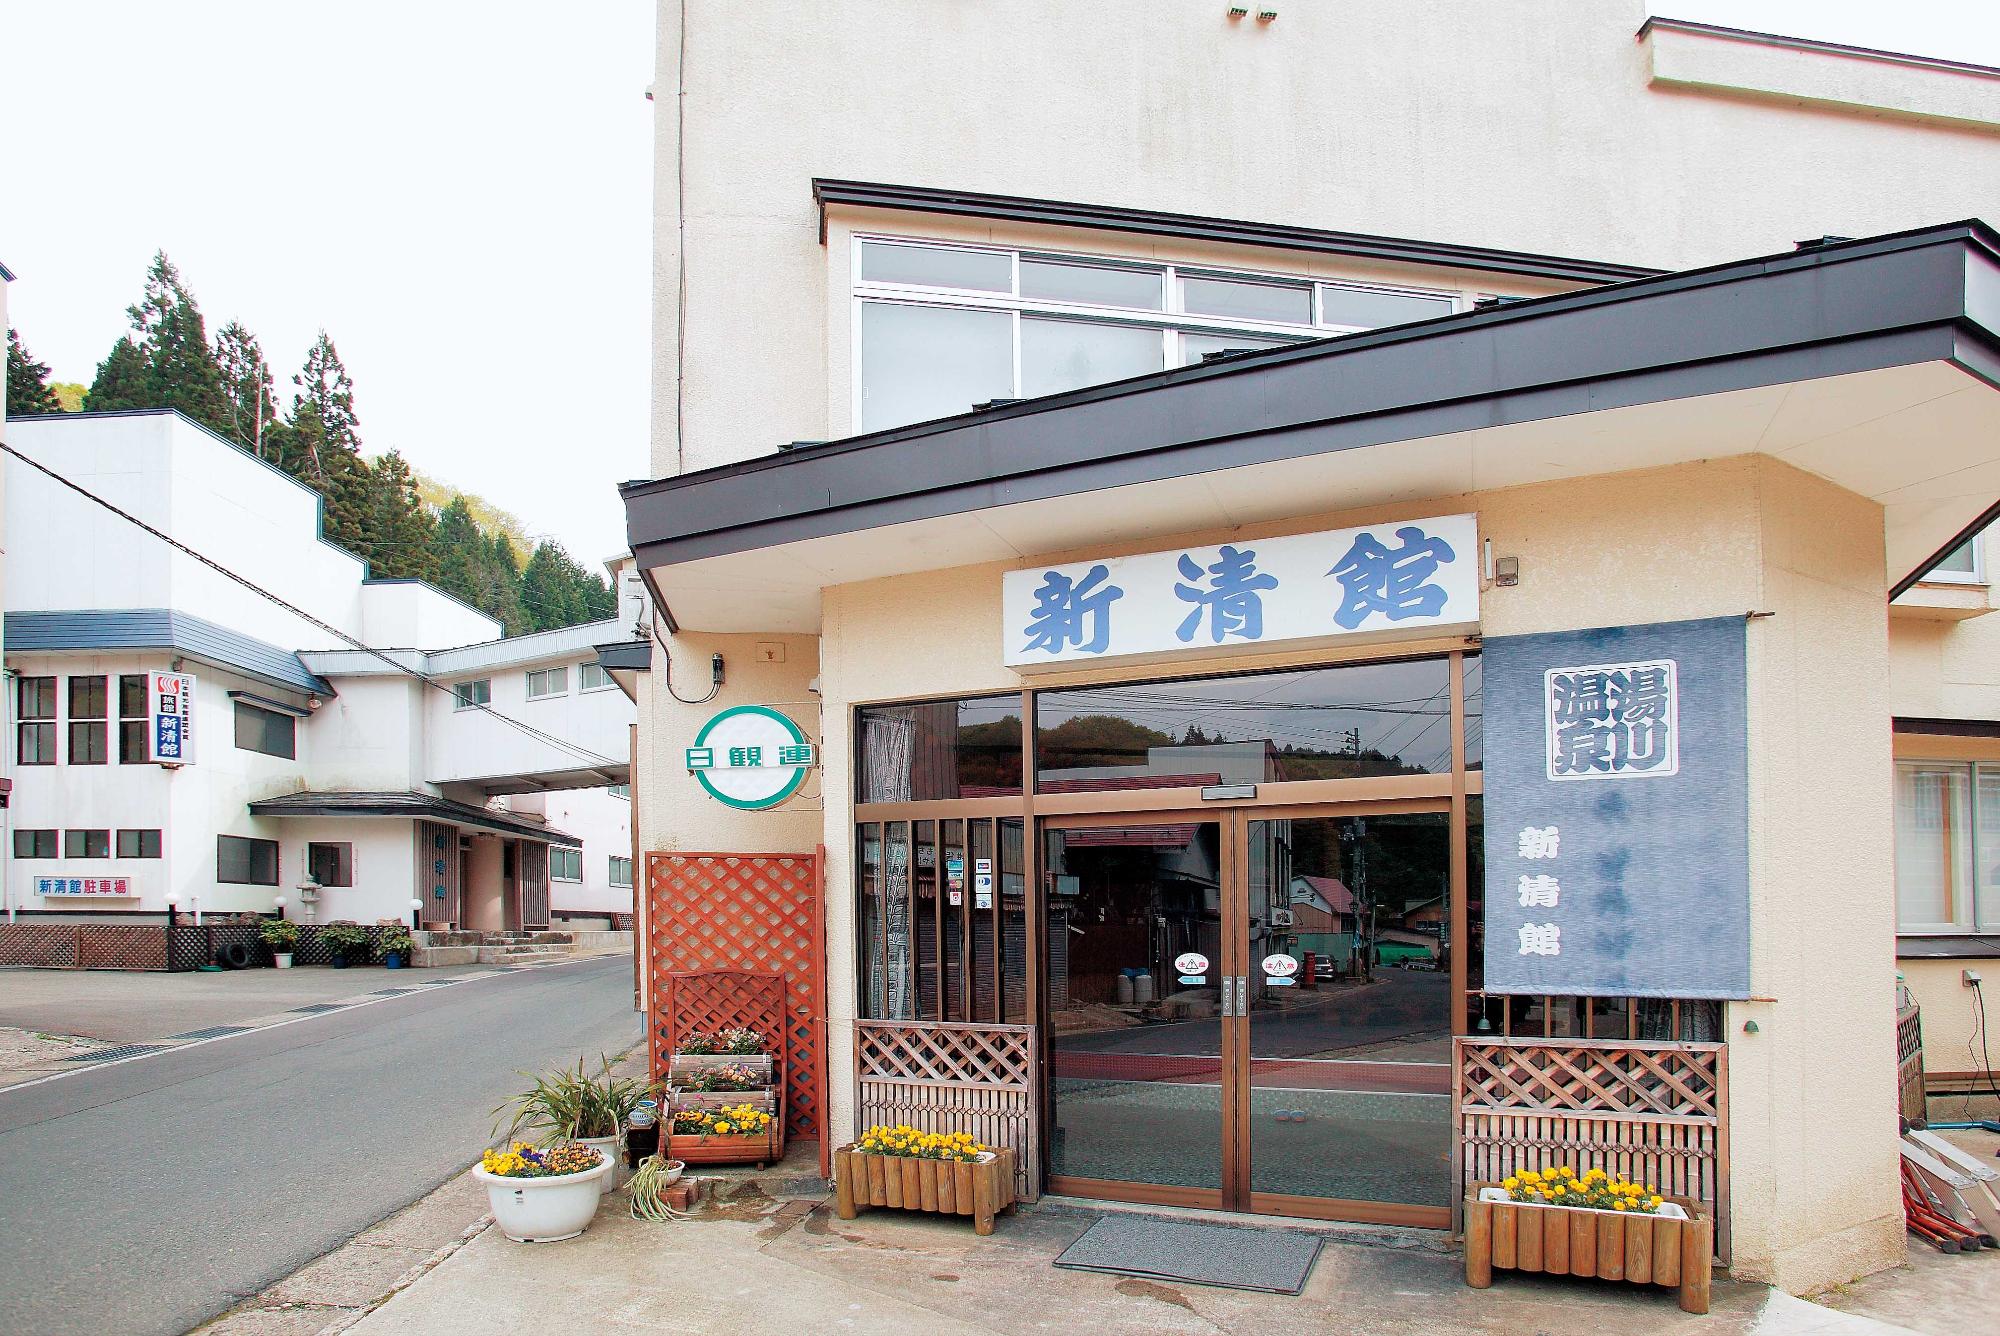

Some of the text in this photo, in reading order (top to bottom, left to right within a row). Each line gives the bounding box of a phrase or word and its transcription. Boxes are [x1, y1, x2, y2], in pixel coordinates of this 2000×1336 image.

[1020, 526, 1456, 654] 新清館
[162, 695, 175, 713] 旅館
[161, 717, 178, 756] 新清館
[686, 745, 811, 768] 日観連
[39, 879, 127, 894] 新清館駐車場
[1518, 826, 1560, 956] 新清館
